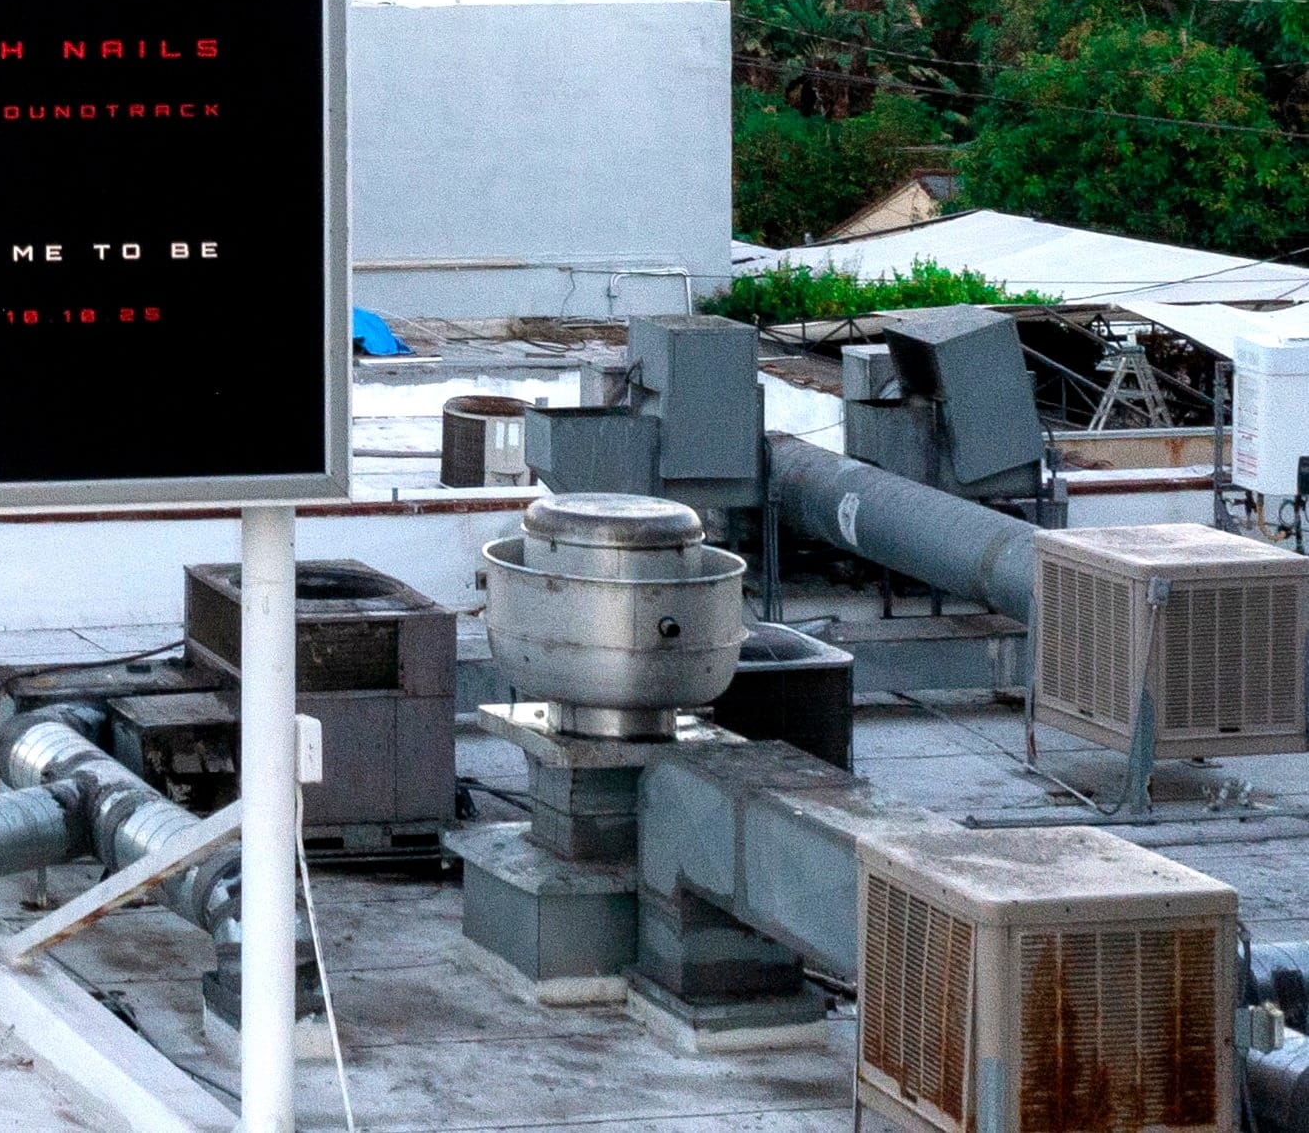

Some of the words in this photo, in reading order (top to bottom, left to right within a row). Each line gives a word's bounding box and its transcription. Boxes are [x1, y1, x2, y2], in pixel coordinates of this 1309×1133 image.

[64, 39, 218, 60] NAILS
[12, 245, 62, 262] ME
[93, 243, 141, 260] TO
[171, 241, 218, 259] BE
